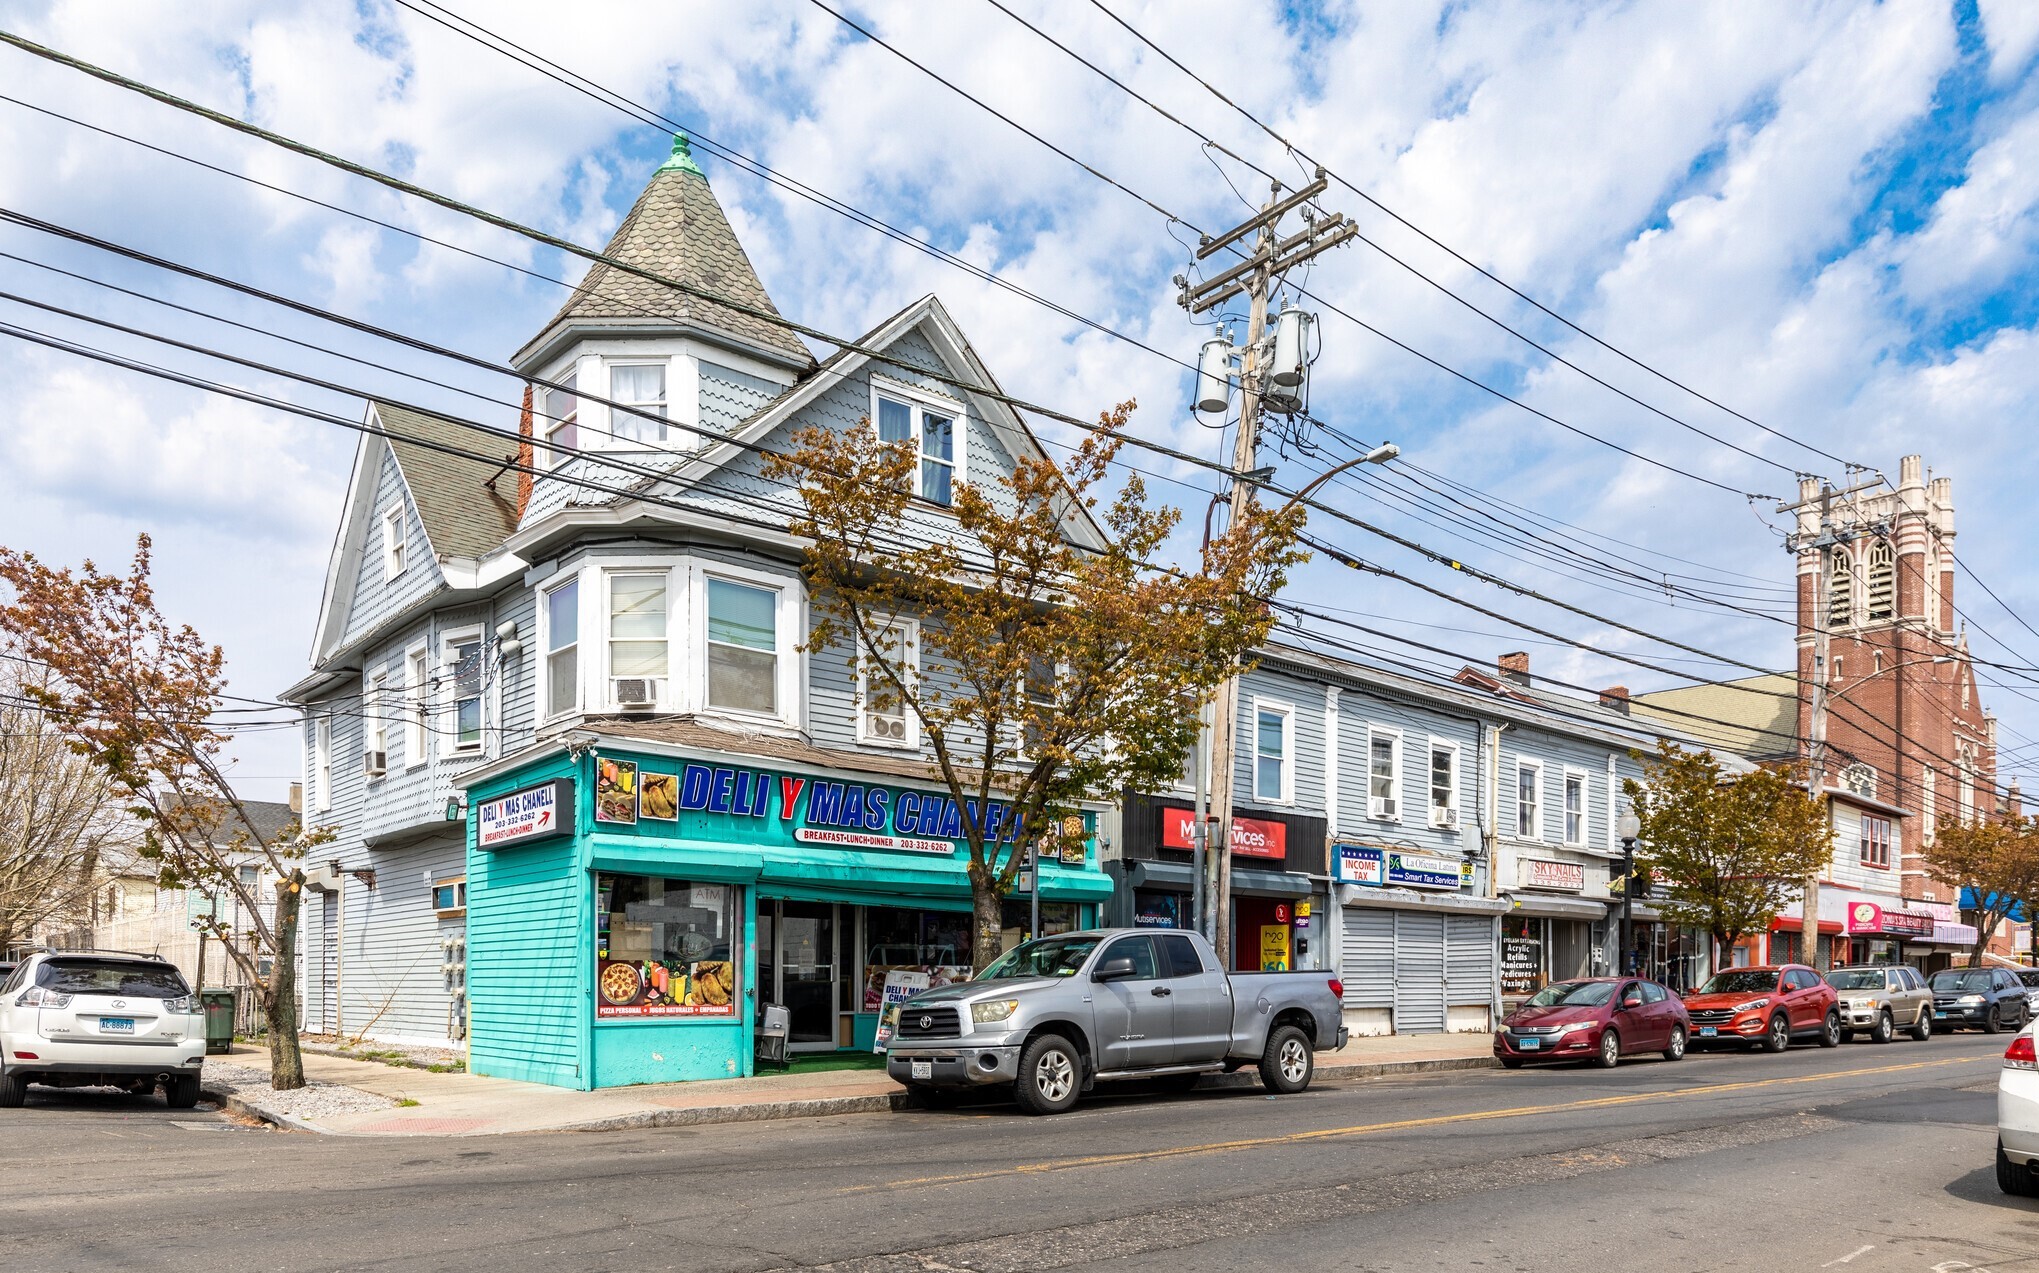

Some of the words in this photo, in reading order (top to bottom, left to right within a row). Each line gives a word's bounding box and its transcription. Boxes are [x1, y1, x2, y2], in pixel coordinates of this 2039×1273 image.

[680, 764, 771, 817] DELI
[781, 776, 806, 820] Y
[807, 781, 890, 831] MAS
[483, 804, 497, 823] DELI
[498, 802, 504, 818] Y
[505, 797, 520, 817] MAS
[522, 787, 554, 812] CHANELL
[494, 811, 536, 829] 203-332-6262
[900, 839, 948, 852] 203-332-6262
[1345, 859, 1376, 871] INCOME
[1406, 858, 1415, 868] La
[1415, 859, 1438, 870] Oficina
[1438, 861, 1457, 872] Latina
[1462, 866, 1472, 875] IRS
[1534, 861, 1553, 875] SKY
[1556, 863, 1582, 877] NAILS
[1353, 871, 1368, 881] TAX
[1404, 872, 1422, 882] Smart
[1423, 874, 1434, 883] Tax
[1434, 875, 1458, 886] Services
[695, 889, 720, 900] ATM
[1507, 944, 1530, 953] Acrylic
[1507, 953, 1528, 961] Refills
[1500, 961, 1532, 969] Manicures
[1500, 970, 1532, 978] Pedicures
[886, 985, 901, 995] DELI
[902, 986, 908, 995] Y
[615, 1006, 642, 1014] PERSONAL
[649, 1006, 666, 1014] JUGOS
